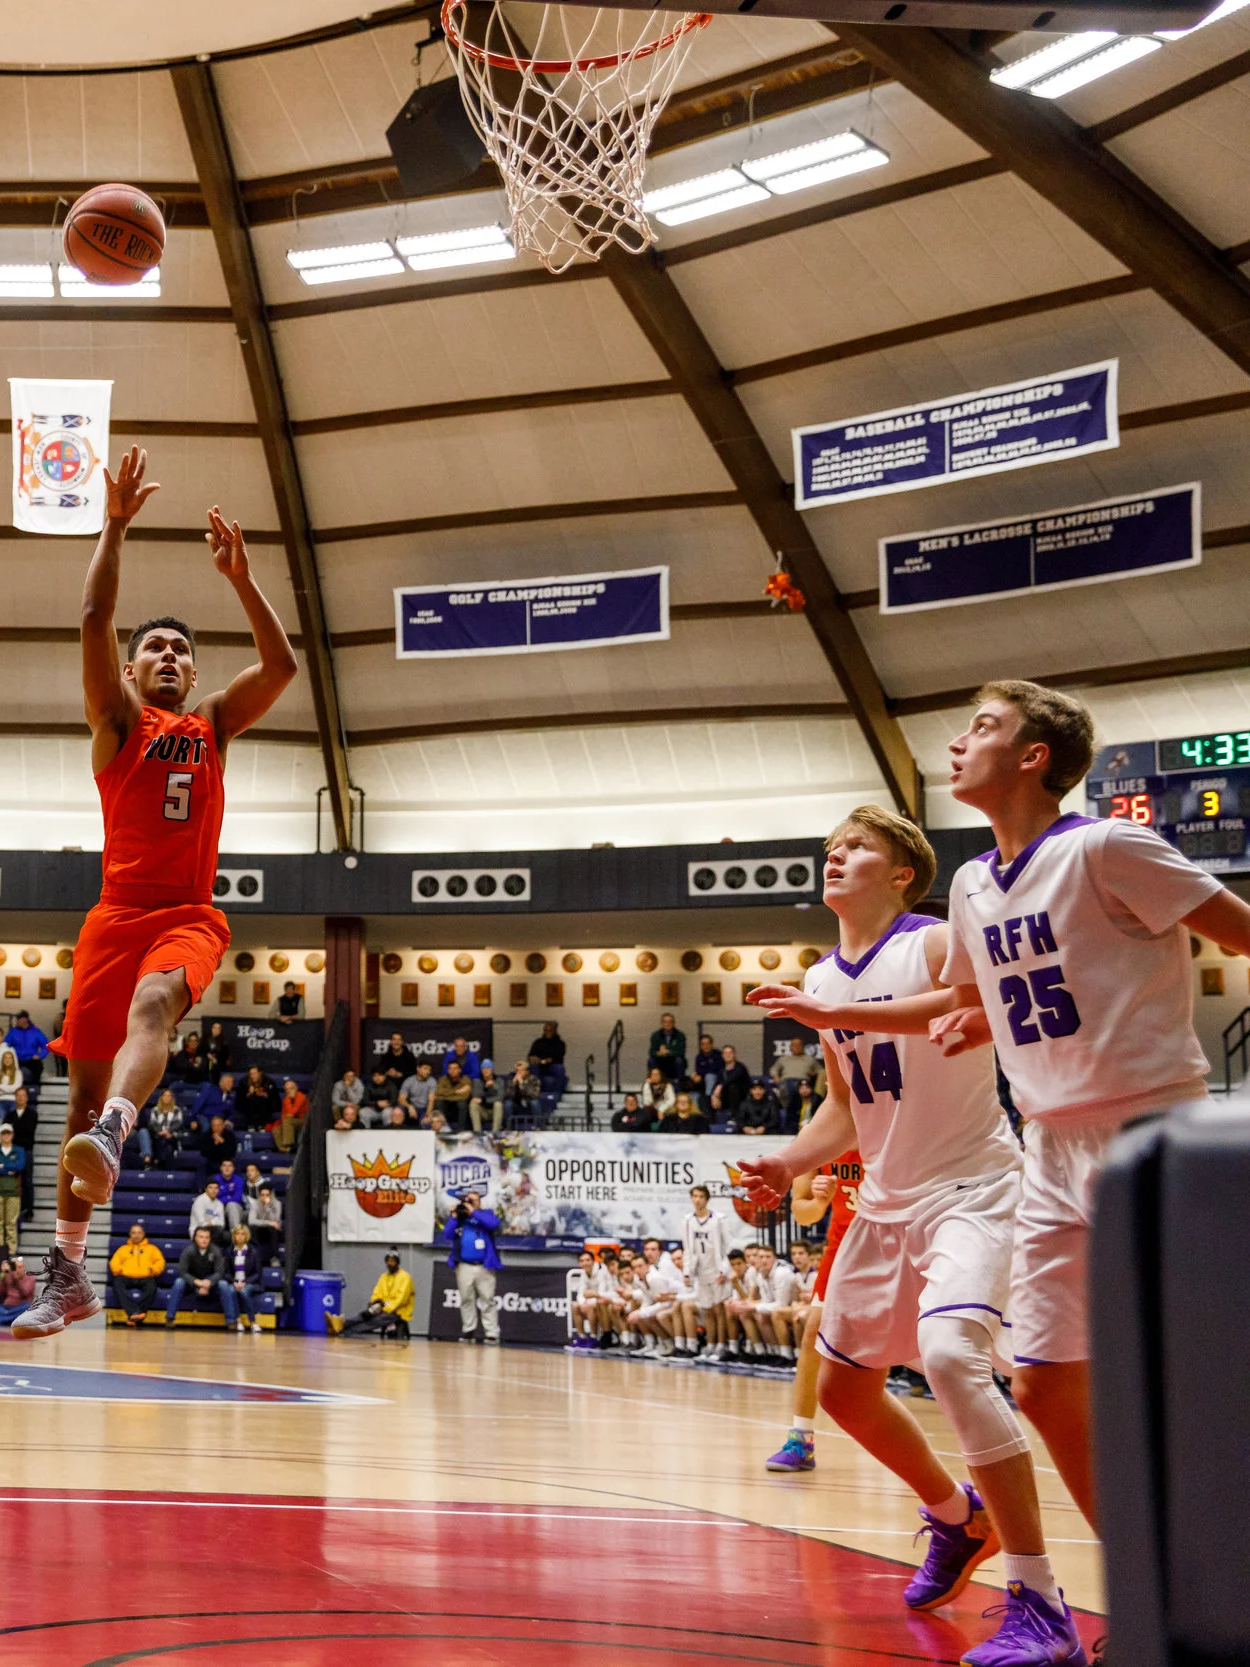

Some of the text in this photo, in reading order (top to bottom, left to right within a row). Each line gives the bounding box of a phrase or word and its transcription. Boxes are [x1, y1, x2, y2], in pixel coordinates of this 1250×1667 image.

[92, 223, 123, 250] THE
[845, 413, 926, 440] BASEBALL
[930, 383, 1064, 423] CHAMPIONSHIPS
[918, 500, 1155, 552] MEN'S LACROSSE CHAMPIONSHIPS
[448, 583, 606, 605] GOLF CHAMPIONSHIPS
[1181, 732, 1250, 766] 4:33
[162, 771, 194, 822] 5
[1102, 778, 1147, 794] BLUES
[1109, 793, 1152, 826] 26
[1203, 791, 1221, 816] 3
[1176, 821, 1215, 834] PLAYER
[982, 911, 1059, 967] RFH
[999, 964, 1082, 1046] 25
[237, 1025, 276, 1040] Hoop
[246, 1036, 290, 1052] Group
[846, 1041, 903, 1105] 14
[545, 1159, 695, 1185] OPPORTUNITIES
[545, 1185, 583, 1200] START
[587, 1186, 618, 1201] HERE
